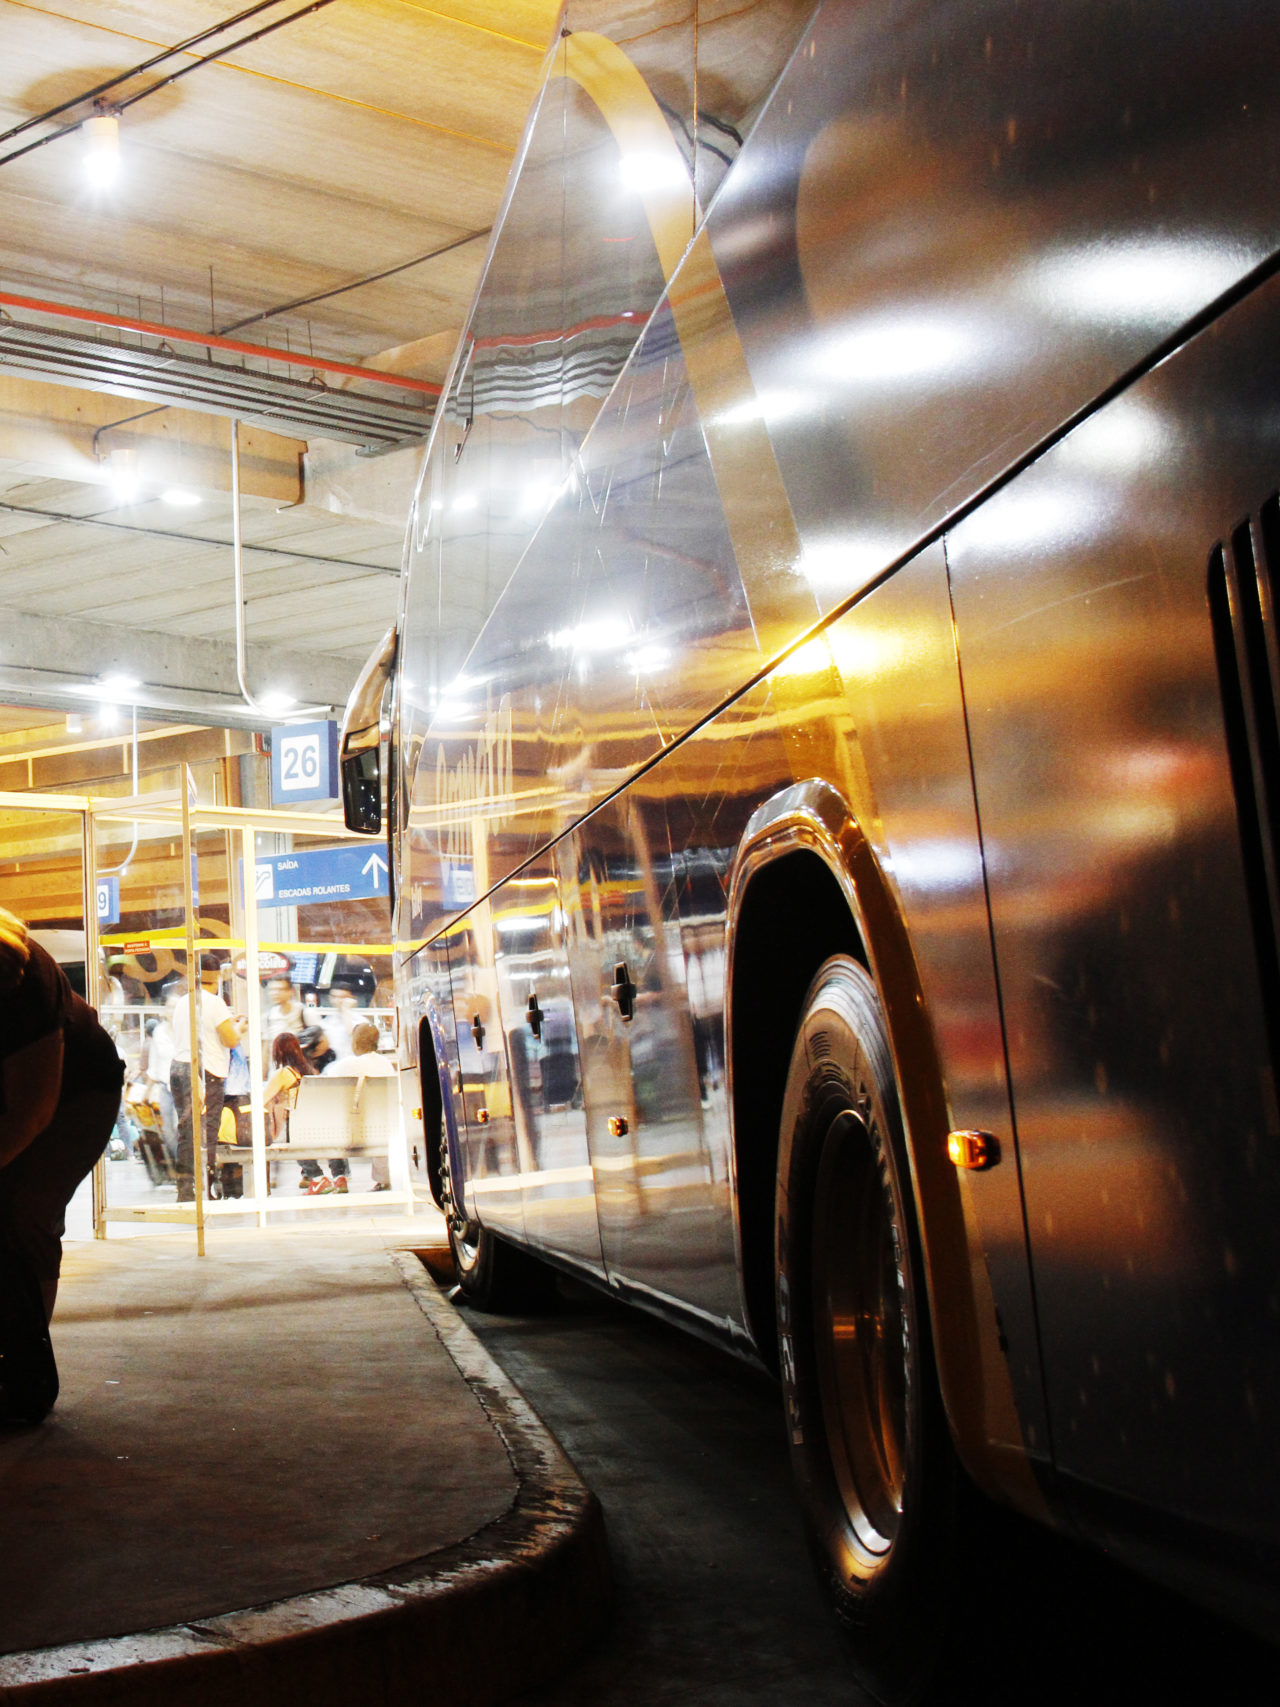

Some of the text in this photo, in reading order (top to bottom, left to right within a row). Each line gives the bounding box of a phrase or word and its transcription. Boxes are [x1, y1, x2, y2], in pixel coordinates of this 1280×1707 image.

[284, 745, 317, 780] 26
[277, 859, 299, 871] SAÍDA
[279, 884, 351, 899] ESCADAS ROLANTES
